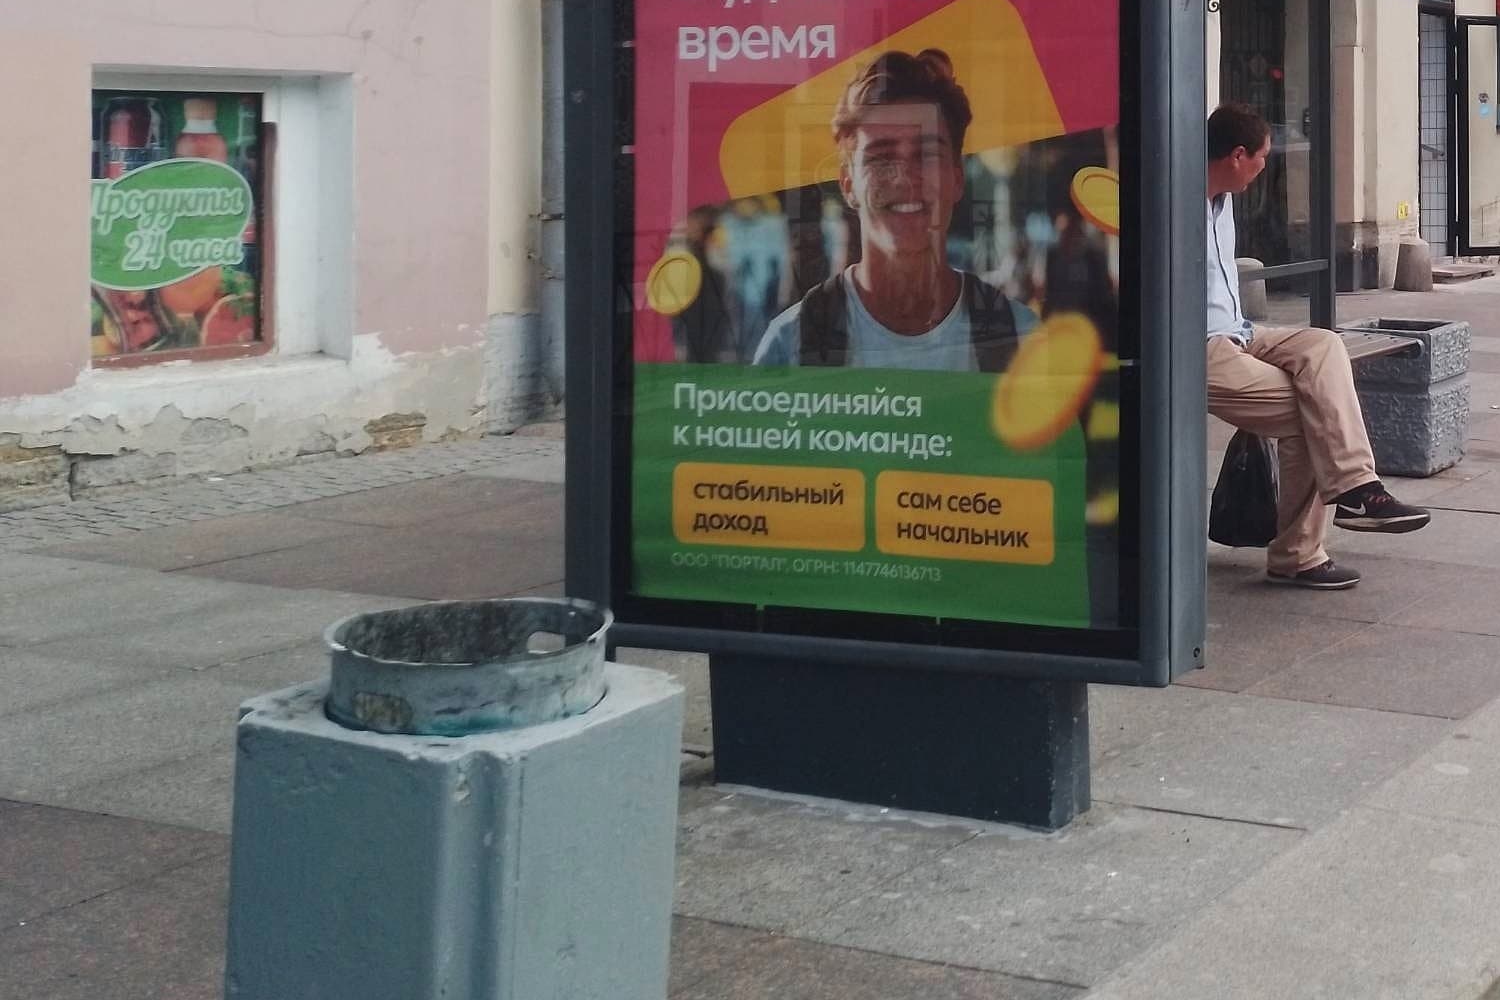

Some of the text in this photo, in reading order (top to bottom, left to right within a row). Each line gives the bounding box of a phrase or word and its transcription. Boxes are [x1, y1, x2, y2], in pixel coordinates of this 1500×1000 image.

[677, 25, 836, 71] время
[122, 231, 244, 271] 24 часа
[673, 382, 923, 418] Присоединяйся
[673, 420, 953, 460] к нашей команде:
[693, 480, 844, 506] стабильный
[897, 489, 1002, 516] сам себе
[693, 511, 768, 536] доход
[897, 520, 1029, 549] начальник
[671, 552, 708, 568] ООО
